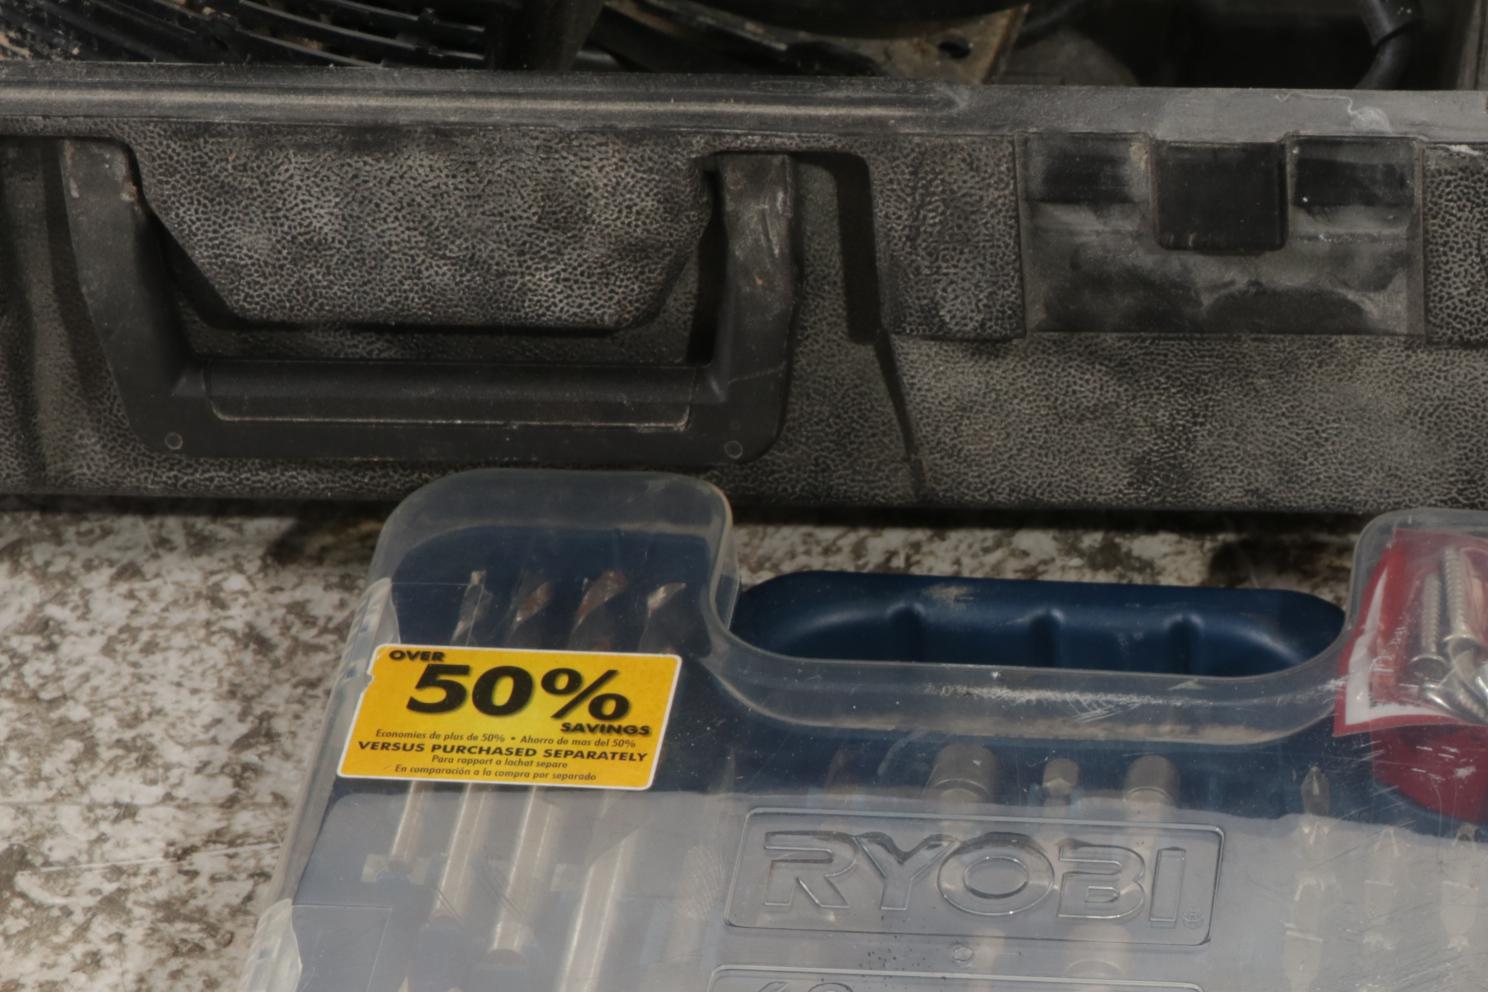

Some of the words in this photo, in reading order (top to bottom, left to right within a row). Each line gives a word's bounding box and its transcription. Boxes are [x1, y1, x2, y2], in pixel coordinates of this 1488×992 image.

[389, 650, 446, 662] OVER
[406, 663, 631, 721] 50%
[375, 728, 426, 739] Economies
[429, 730, 441, 740] de
[444, 731, 464, 742] plus
[467, 732, 478, 741] de
[482, 733, 505, 743] 50%
[561, 722, 651, 735] SAVINGS
[520, 735, 553, 745] Ahorro
[557, 736, 569, 745] de
[594, 737, 609, 747] del
[611, 738, 636, 748] 50%
[358, 741, 425, 752] VERSUS
[431, 744, 537, 757] PURCHASED
[543, 748, 648, 762] SEPARATELY
[395, 764, 407, 773] En
[410, 765, 470, 777] comparación
[552, 772, 597, 782] separado
[764, 830, 1188, 930] RYOBI
